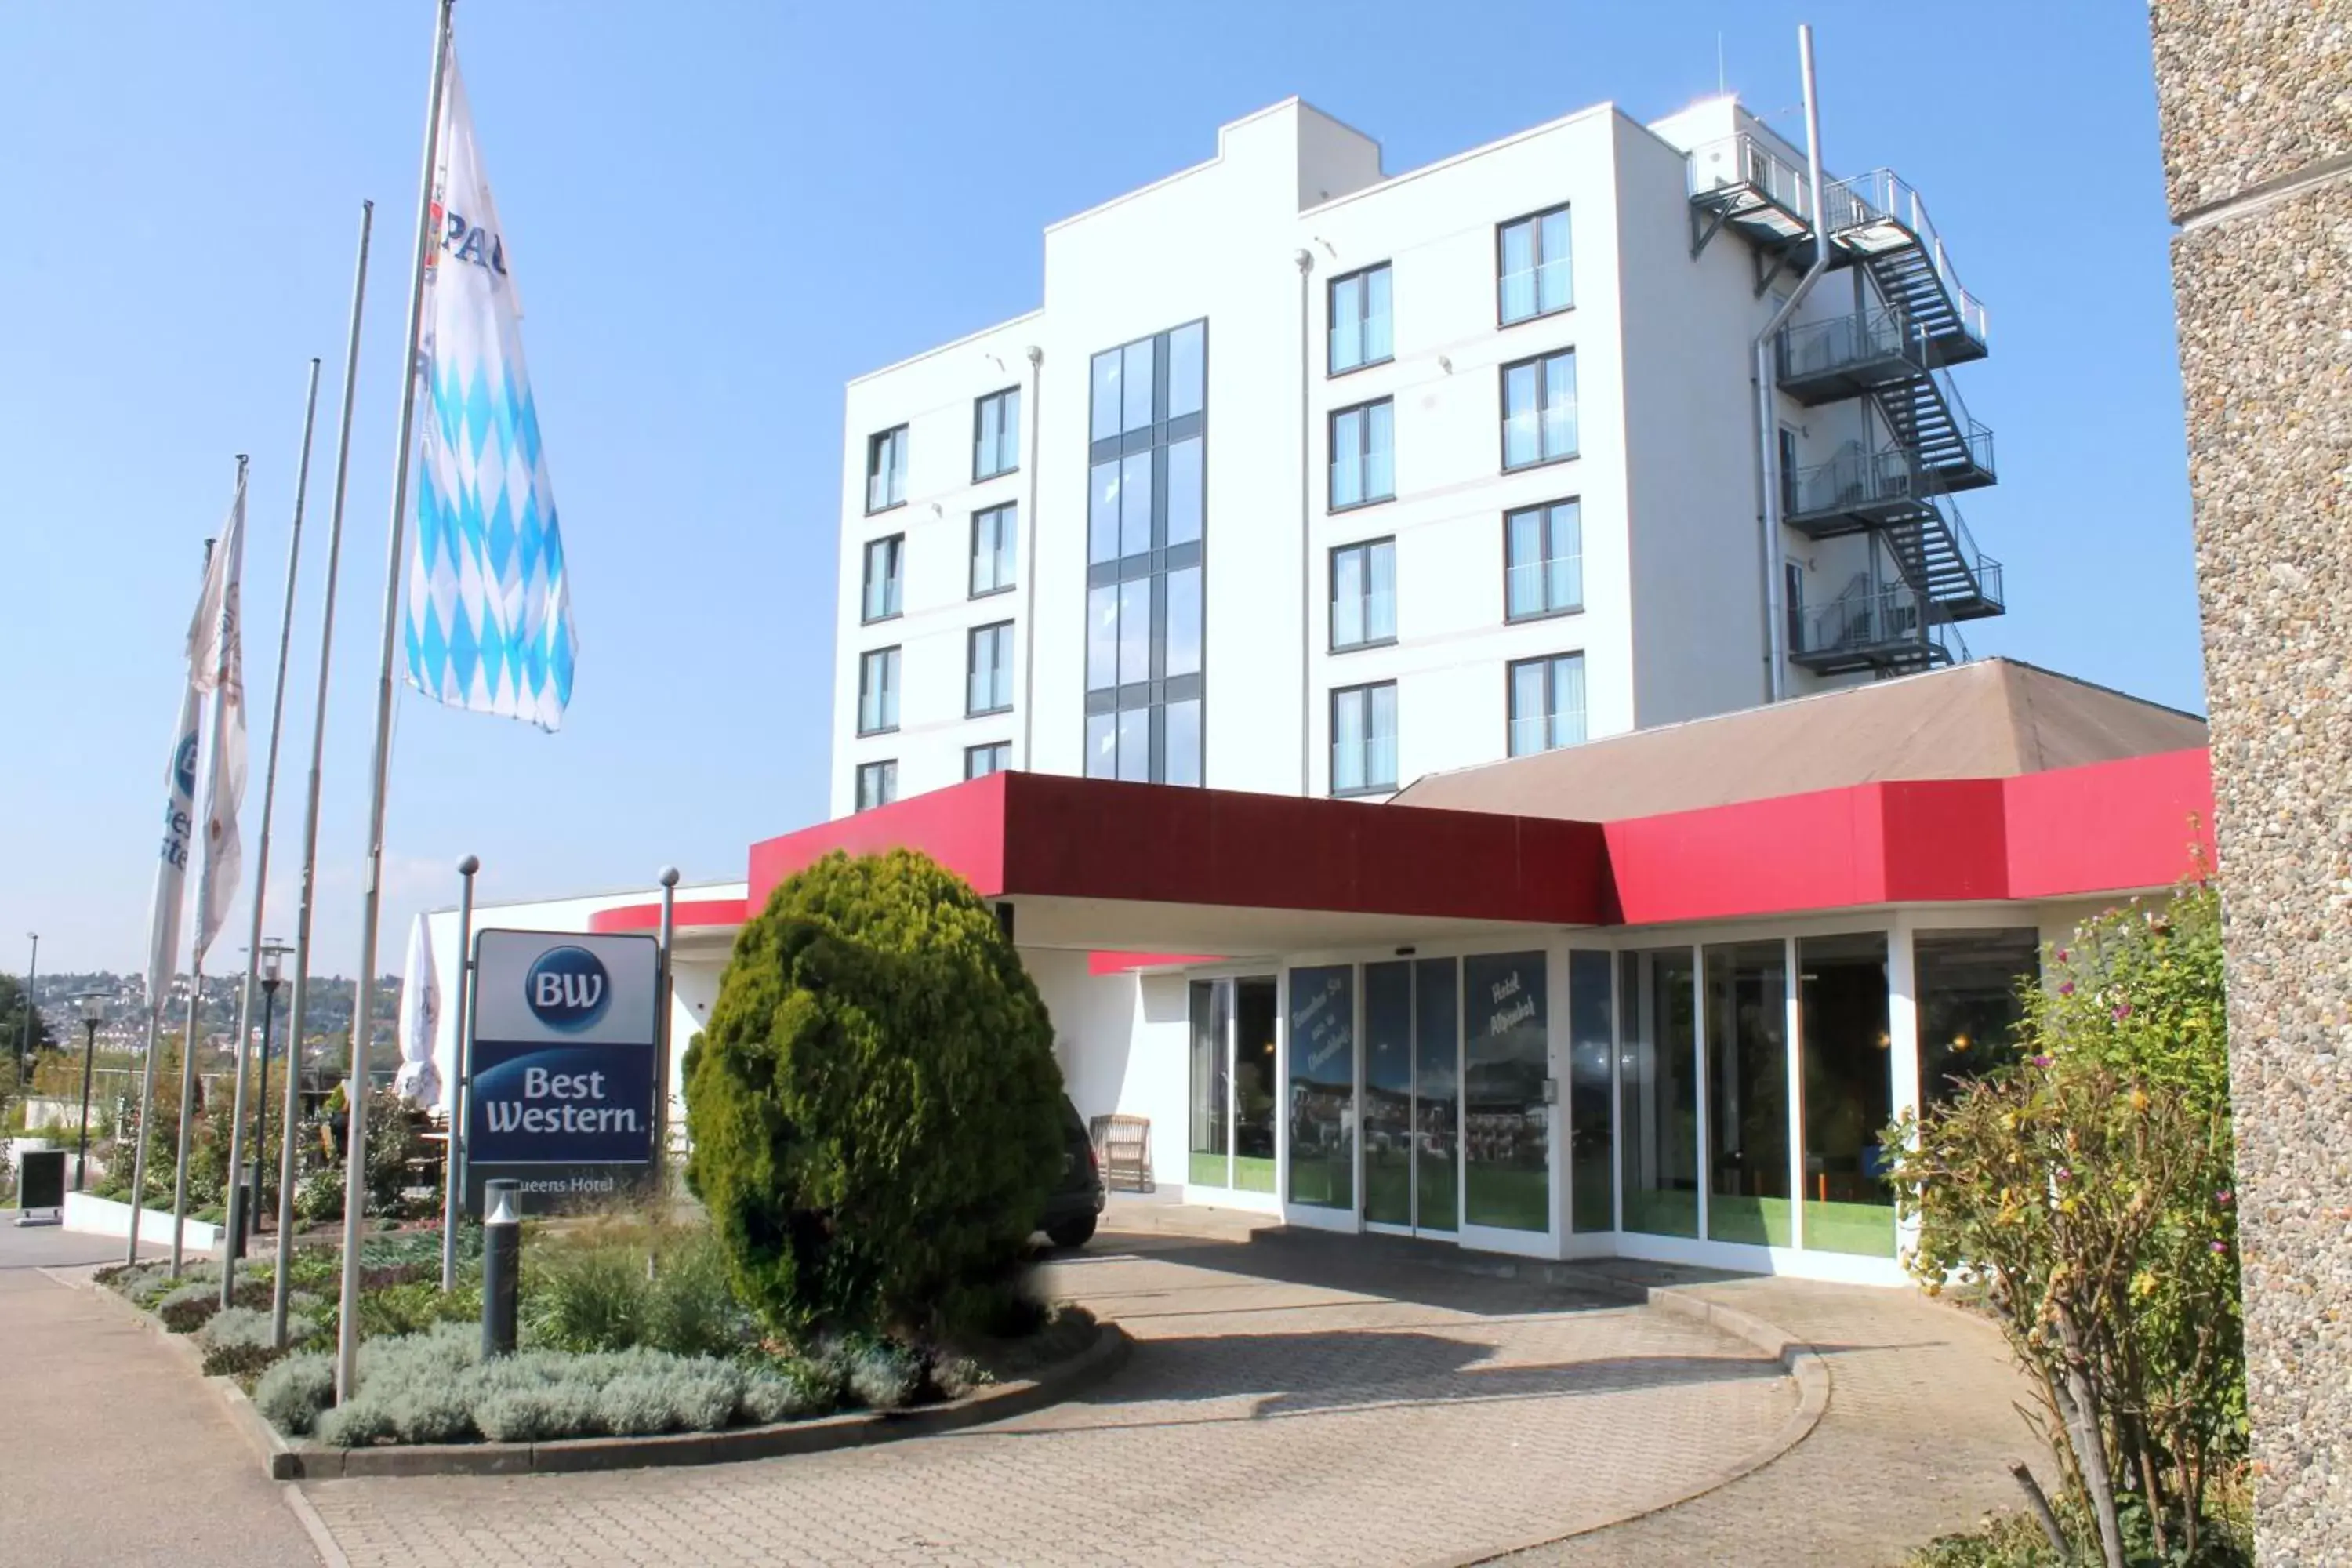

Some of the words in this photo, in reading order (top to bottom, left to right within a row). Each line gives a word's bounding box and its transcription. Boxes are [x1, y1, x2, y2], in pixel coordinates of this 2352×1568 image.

[535, 972, 602, 1007] BW
[524, 1066, 605, 1099] Best
[486, 1101, 637, 1133] Western
[520, 1180, 566, 1192] ueens
[570, 1178, 614, 1192] Hotel
